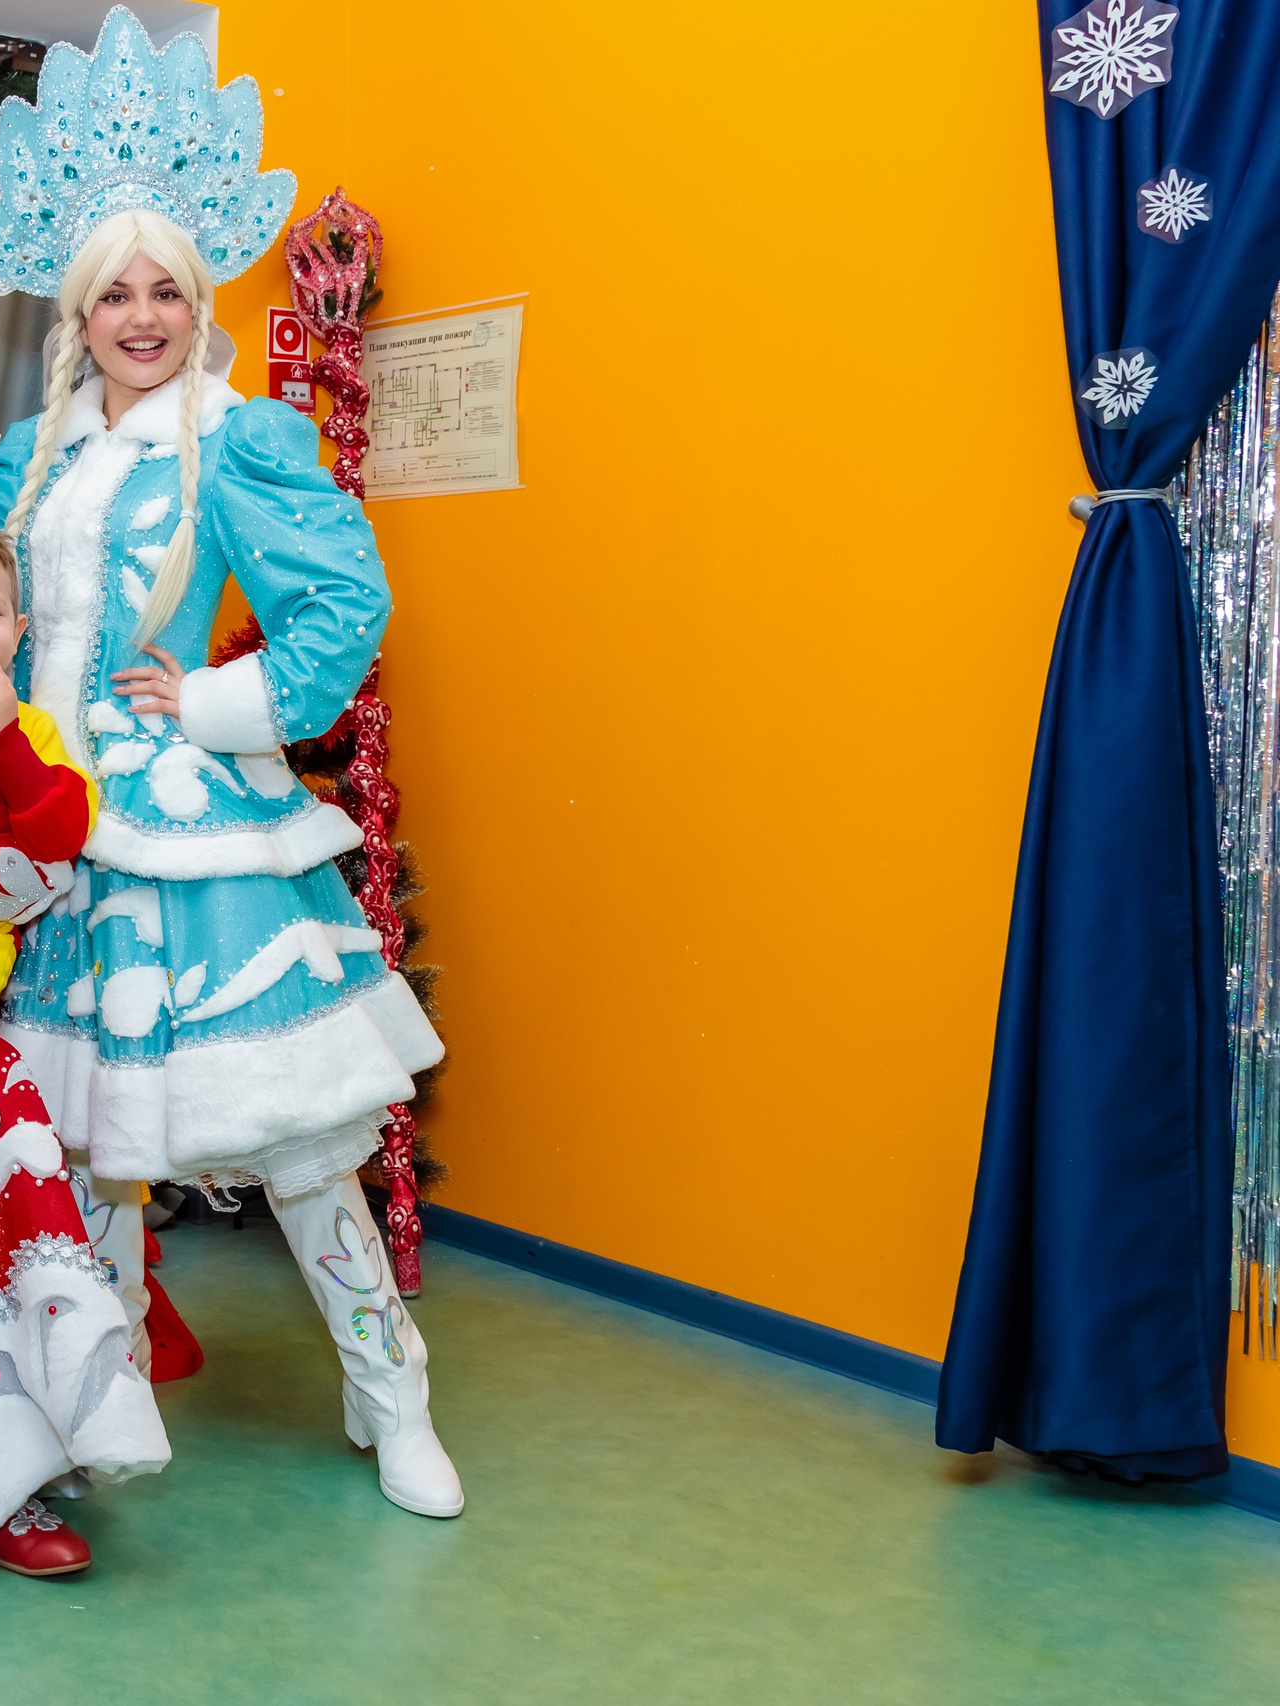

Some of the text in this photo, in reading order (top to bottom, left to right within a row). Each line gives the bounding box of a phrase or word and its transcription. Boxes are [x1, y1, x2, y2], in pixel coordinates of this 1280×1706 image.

[369, 343, 387, 352] План
[389, 337, 426, 349] эвакуации
[428, 335, 442, 344] при
[445, 329, 472, 340] пожаре
